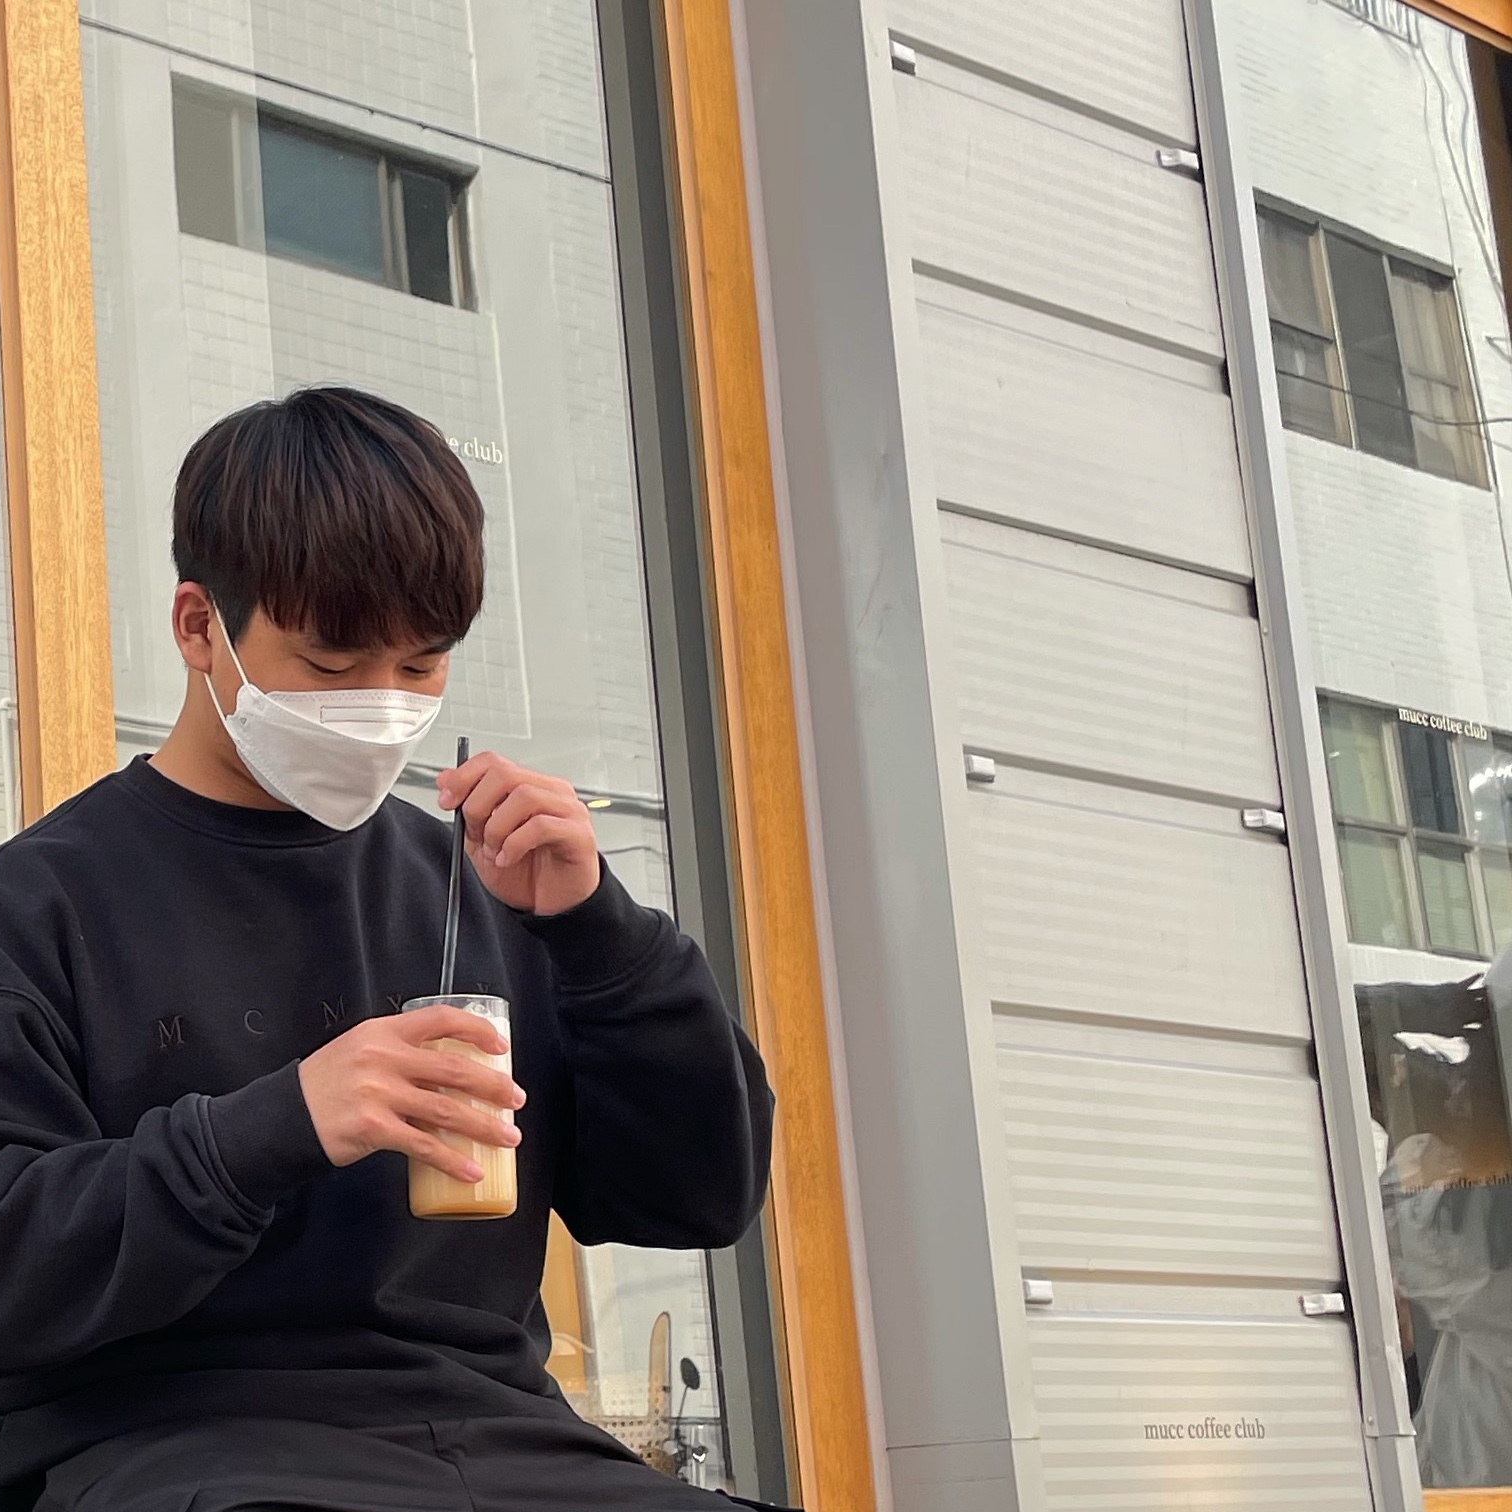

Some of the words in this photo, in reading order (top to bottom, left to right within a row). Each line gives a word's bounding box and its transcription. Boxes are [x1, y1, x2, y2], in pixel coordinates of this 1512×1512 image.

[463, 436, 503, 464] club
[1398, 707, 1429, 727] mucc
[1464, 721, 1487, 740] club
[1144, 1424, 1184, 1440] mucc
[1188, 1416, 1231, 1439] coffee
[1235, 1416, 1265, 1440] club
